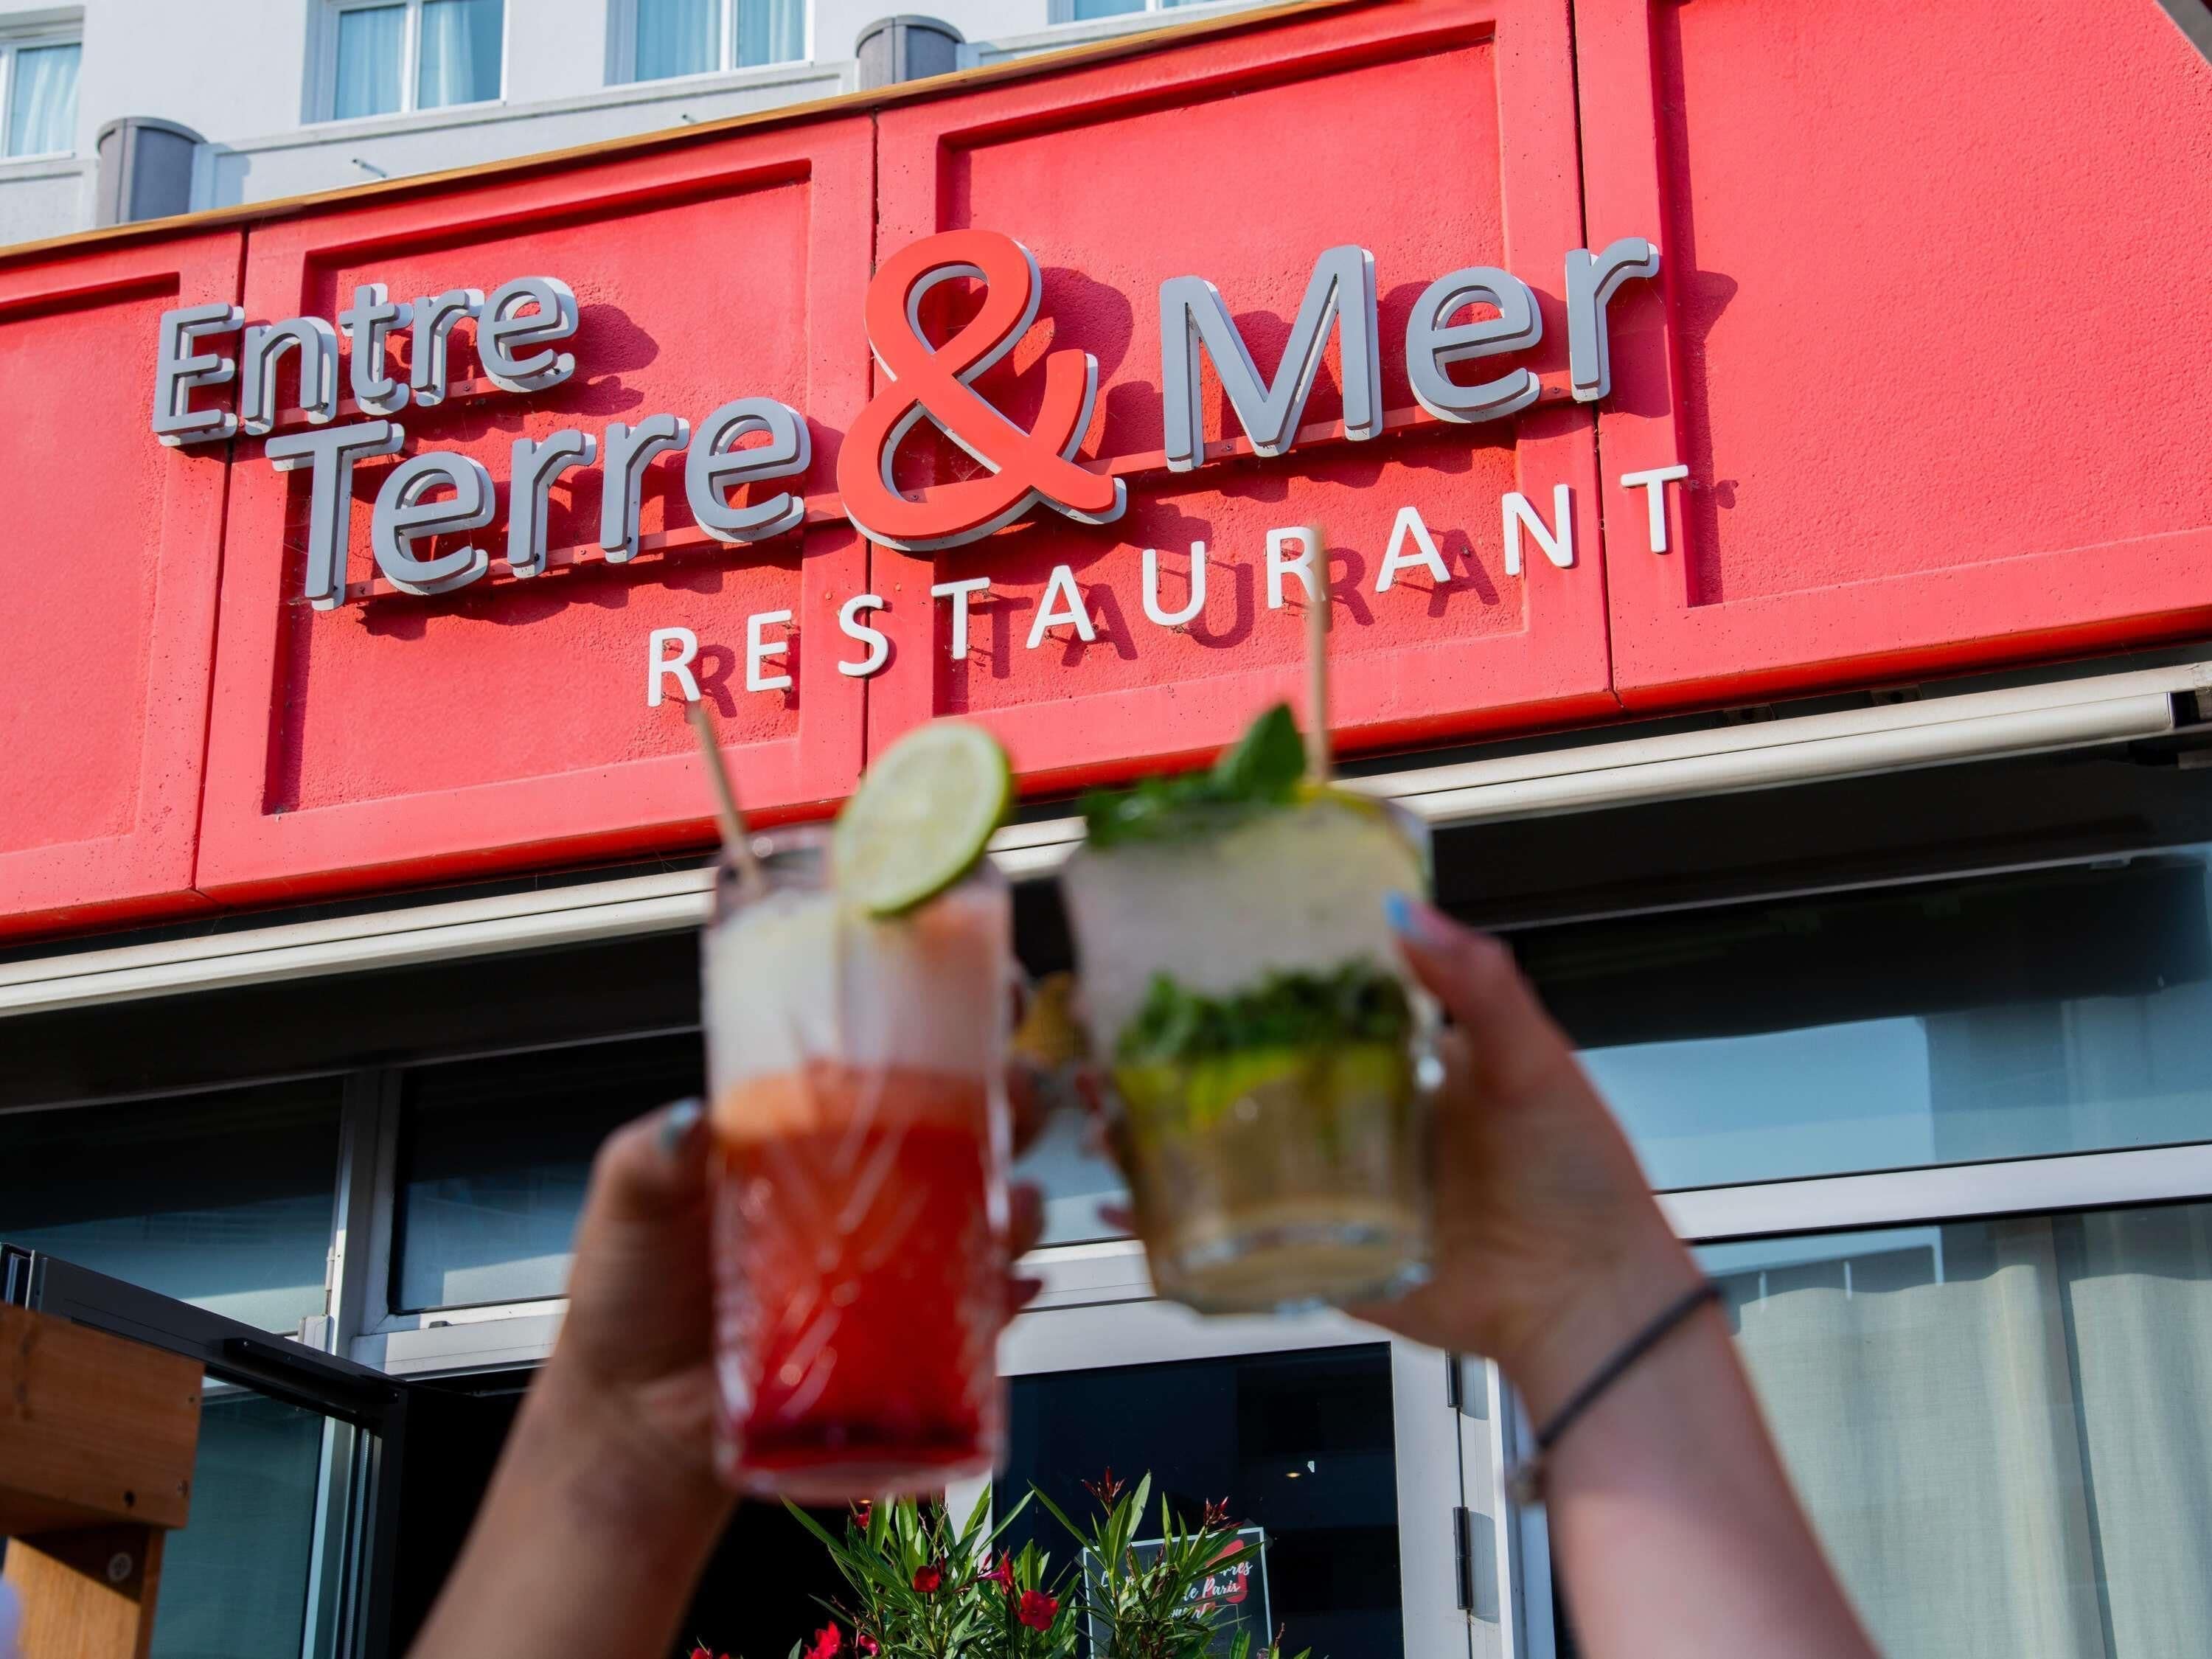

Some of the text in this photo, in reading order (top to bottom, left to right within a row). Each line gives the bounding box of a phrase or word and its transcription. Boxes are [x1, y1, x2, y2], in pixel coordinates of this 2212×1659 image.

[152, 276, 579, 447] Entre
[265, 229, 1659, 611] Terre & Mer
[647, 465, 1688, 706] RESTAURANT
[1202, 1577, 1240, 1599] Paris
